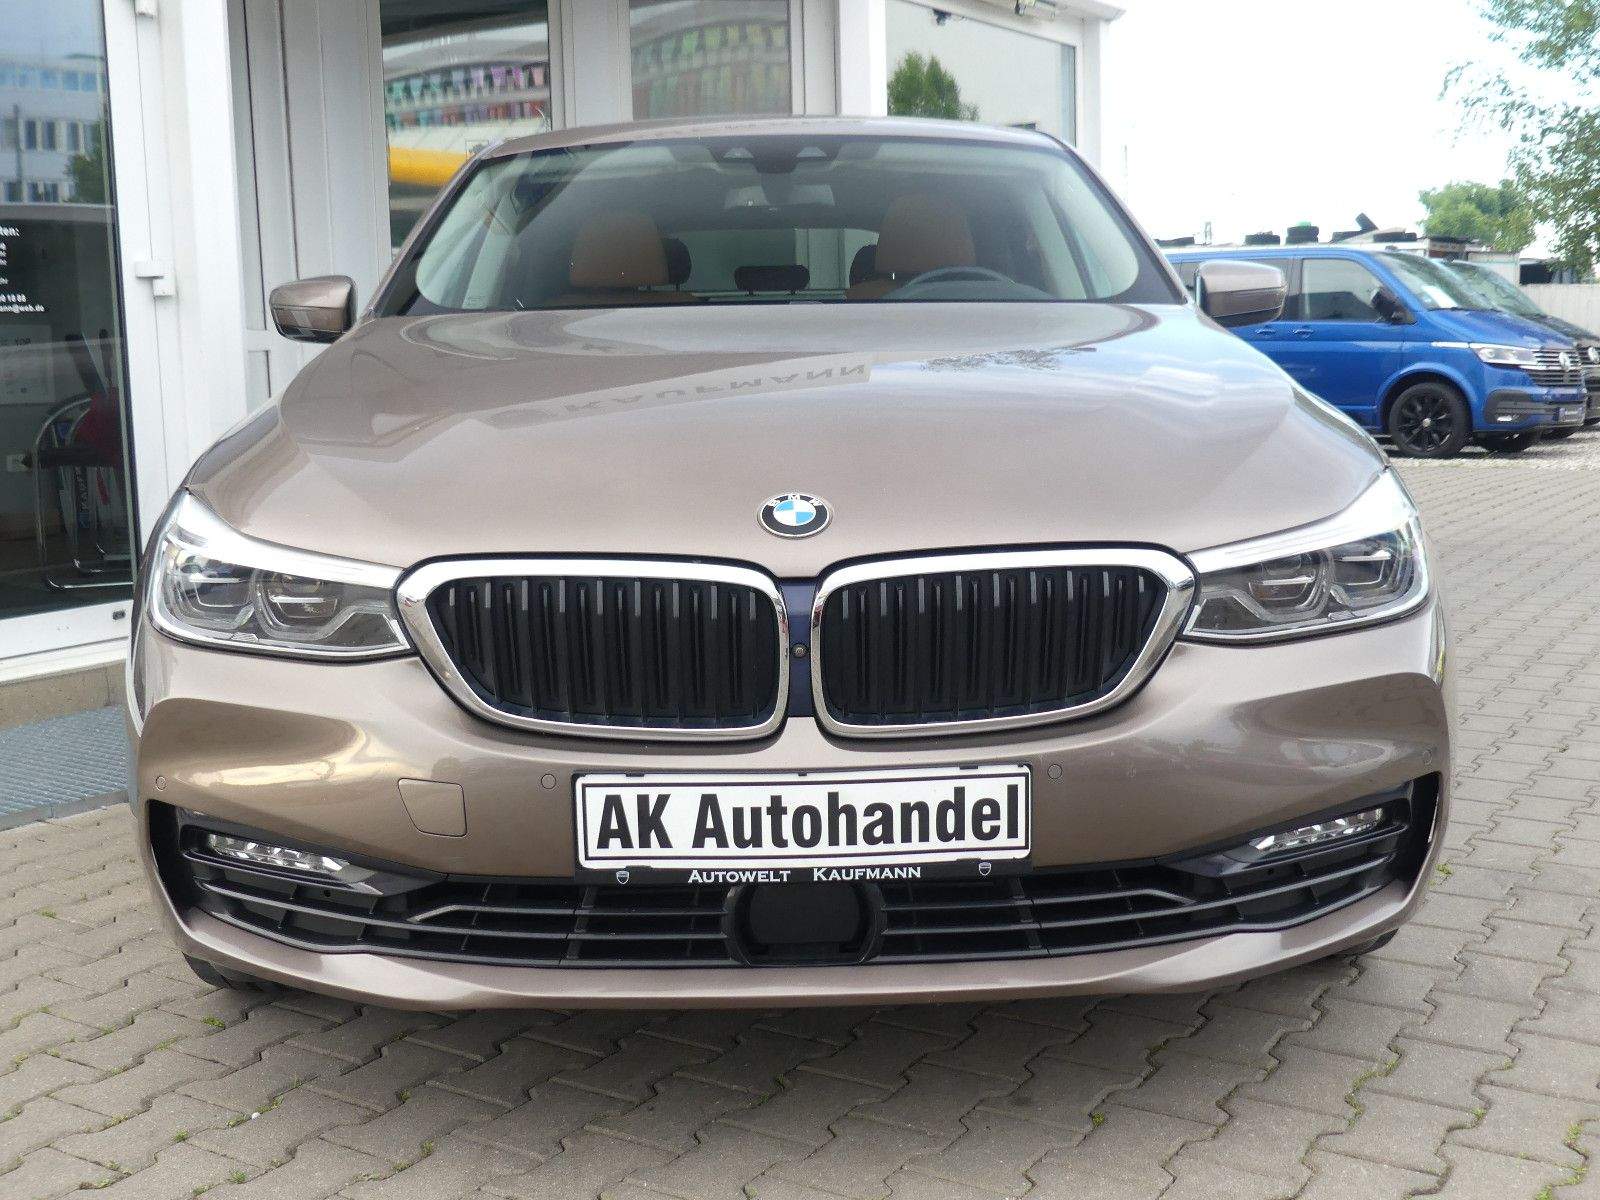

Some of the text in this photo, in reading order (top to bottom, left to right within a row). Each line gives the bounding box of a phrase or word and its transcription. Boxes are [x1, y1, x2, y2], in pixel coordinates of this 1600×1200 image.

[597, 784, 1019, 849] AK Autohandel
[687, 866, 922, 883] AUTOWELT KAUFMANN
